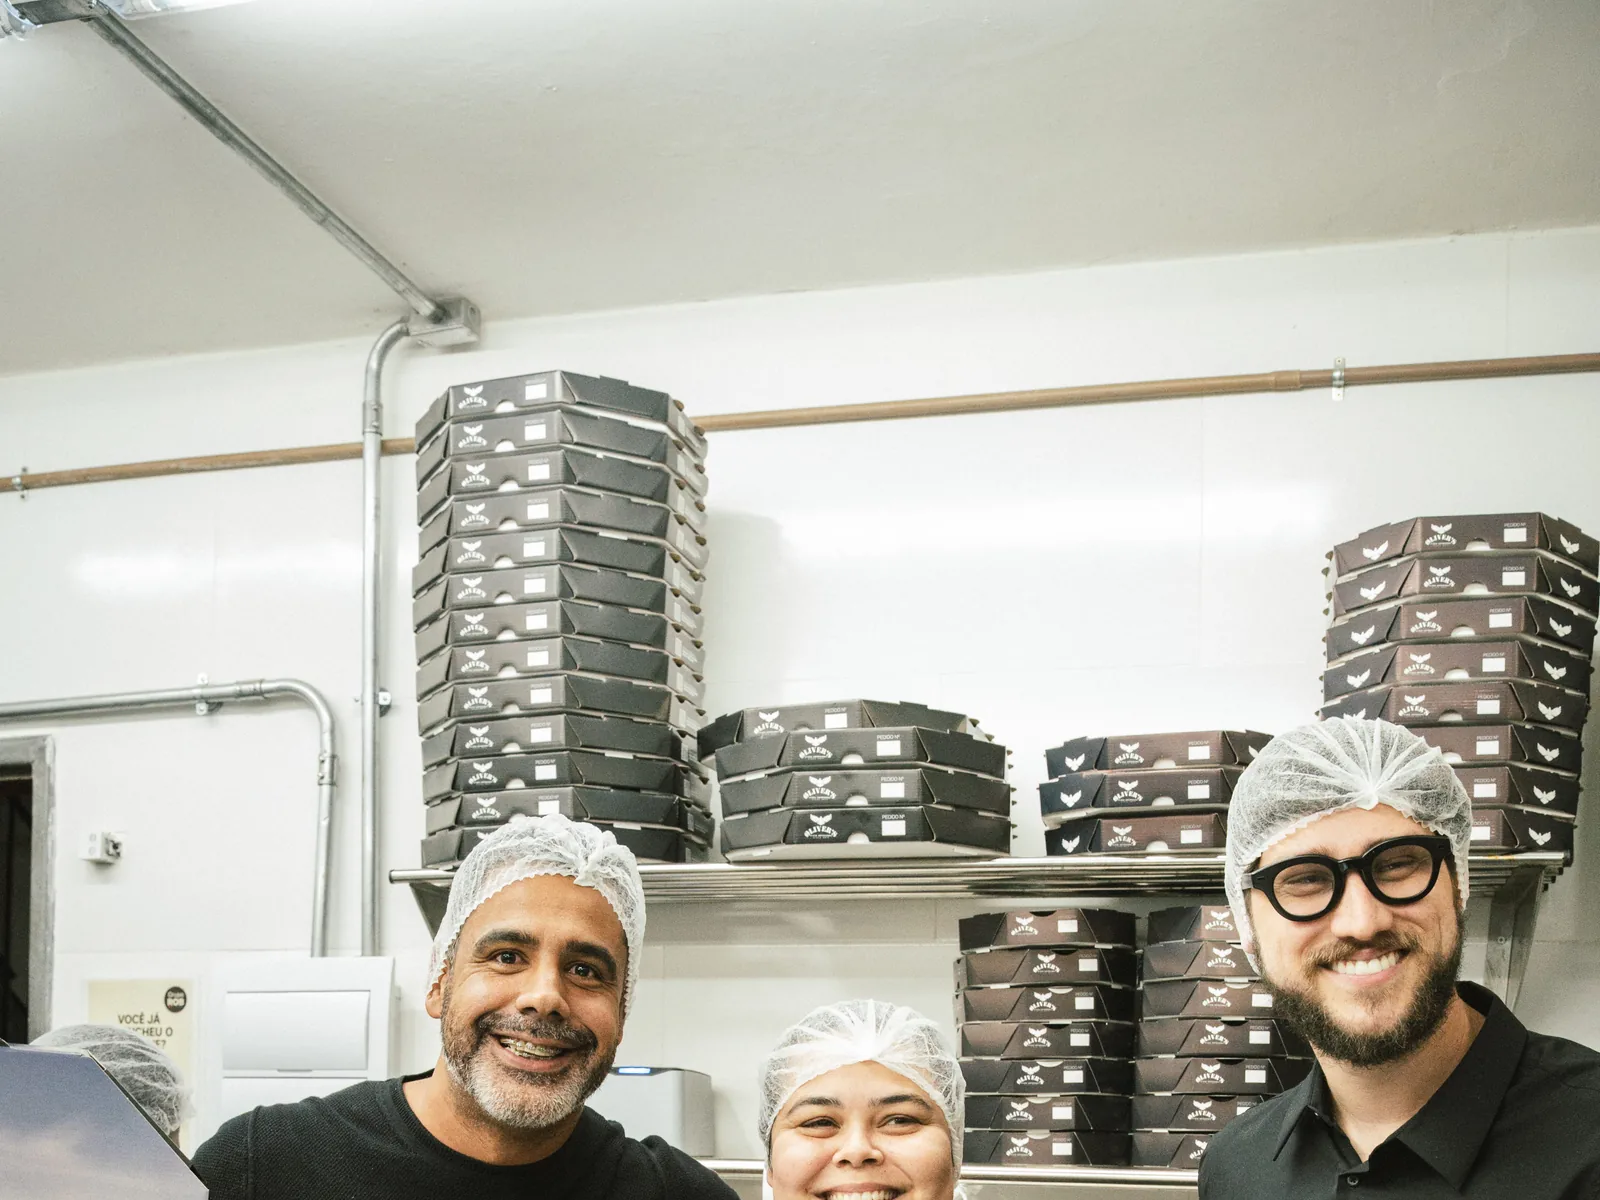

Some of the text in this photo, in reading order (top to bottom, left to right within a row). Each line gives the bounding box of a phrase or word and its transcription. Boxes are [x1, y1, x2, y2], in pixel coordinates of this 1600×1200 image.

[1424, 533, 1457, 546] OLIVER'S
[1423, 575, 1456, 588] OLIVER'S
[1410, 621, 1442, 633] OLIVER'S
[1404, 664, 1436, 675] OLIVER'S
[1398, 706, 1431, 717] OLIVER'S
[754, 722, 785, 734] OLIVER'S
[799, 746, 833, 759] OLIVER'S
[1115, 753, 1144, 764] OLIVER'S
[803, 788, 837, 799] OLIVER'S
[1112, 791, 1143, 802] OLIVER'S
[804, 826, 838, 838] OLIVER'S
[1107, 837, 1136, 847] OLIVER'S
[1011, 925, 1038, 936] OLIVER'S
[1205, 920, 1233, 931] OLIVER'S
[1032, 963, 1060, 973] OLIVER'S
[1207, 958, 1236, 968] OLIVER'S
[1029, 1002, 1057, 1012] OLIVER'S
[1202, 996, 1231, 1007] OLIVER'S
[118, 1012, 160, 1024] VOCÊ JÁ
[165, 1027, 173, 1036] O
[1023, 1037, 1052, 1047] OLIVER'S
[1200, 1034, 1230, 1045] OLIVER'S
[1016, 1075, 1044, 1085] OLIVER'S
[1195, 1073, 1225, 1084] OLIVER'S
[1188, 1110, 1216, 1121] OLIVER'S
